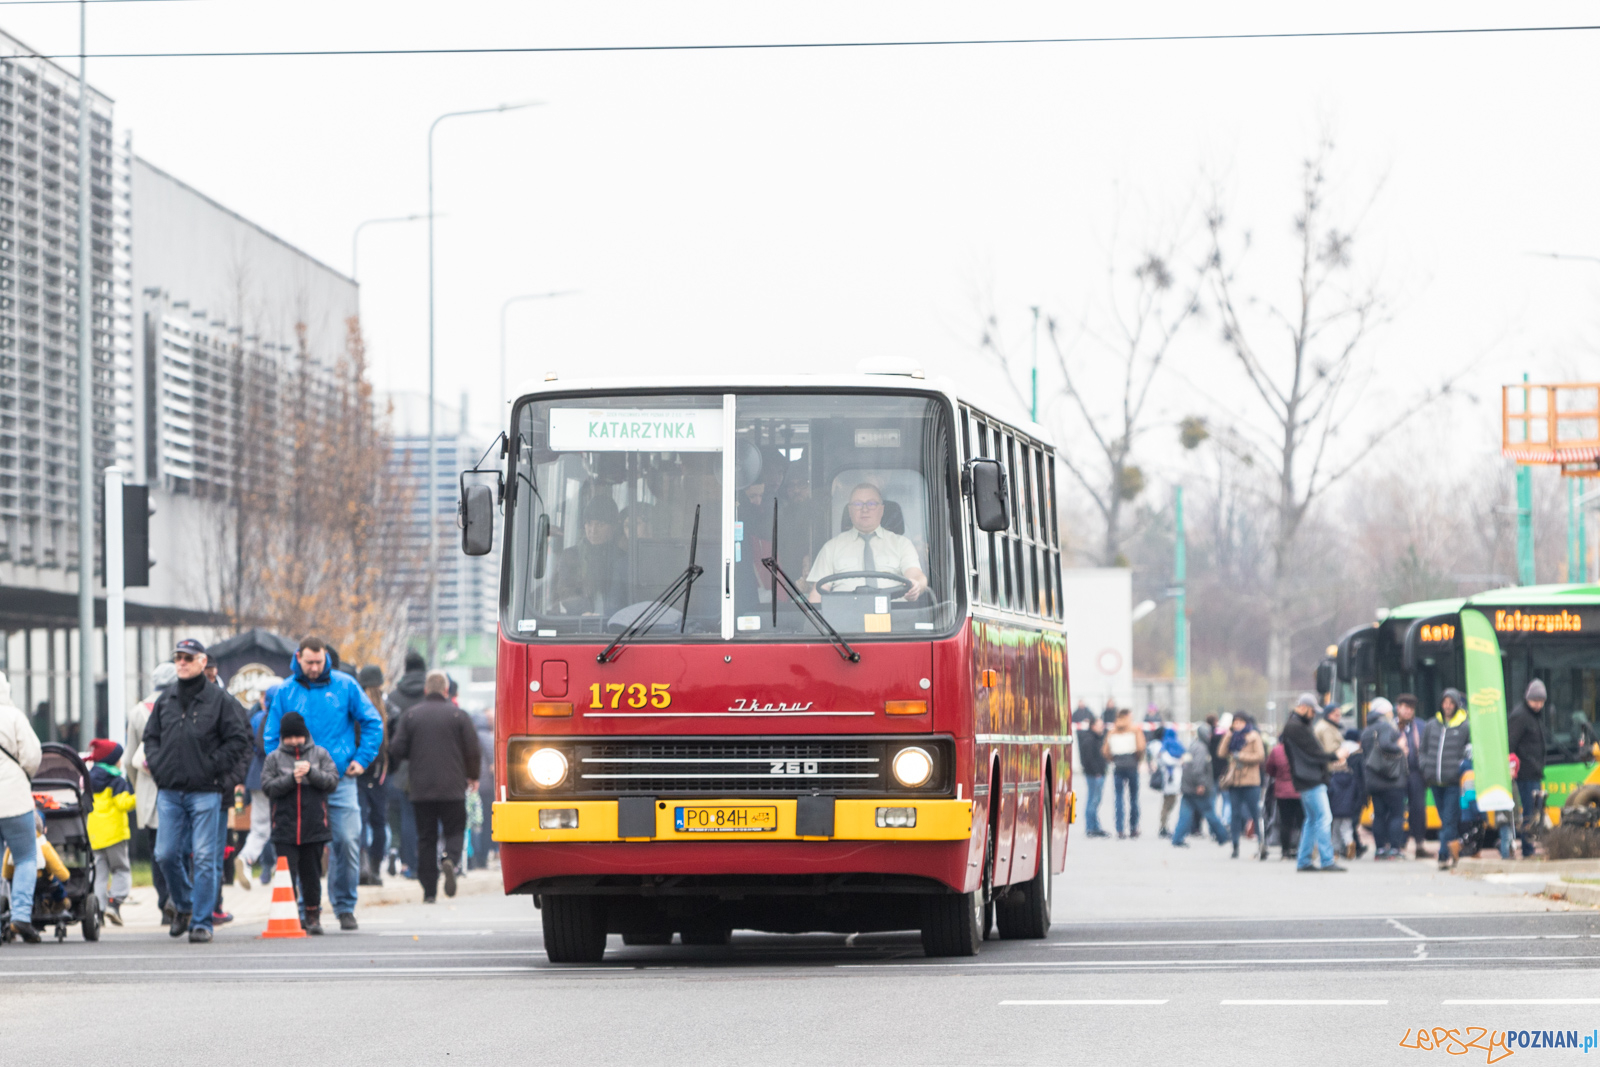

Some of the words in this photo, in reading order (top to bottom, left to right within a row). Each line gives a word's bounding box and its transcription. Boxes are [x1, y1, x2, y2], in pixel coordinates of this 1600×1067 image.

[588, 423, 696, 439] KATARZYNKA
[1494, 609, 1582, 633] Katarzynka
[589, 683, 672, 709] 1735
[727, 698, 814, 713] Ikarus
[687, 809, 709, 826] PO
[716, 809, 748, 826] 84H
